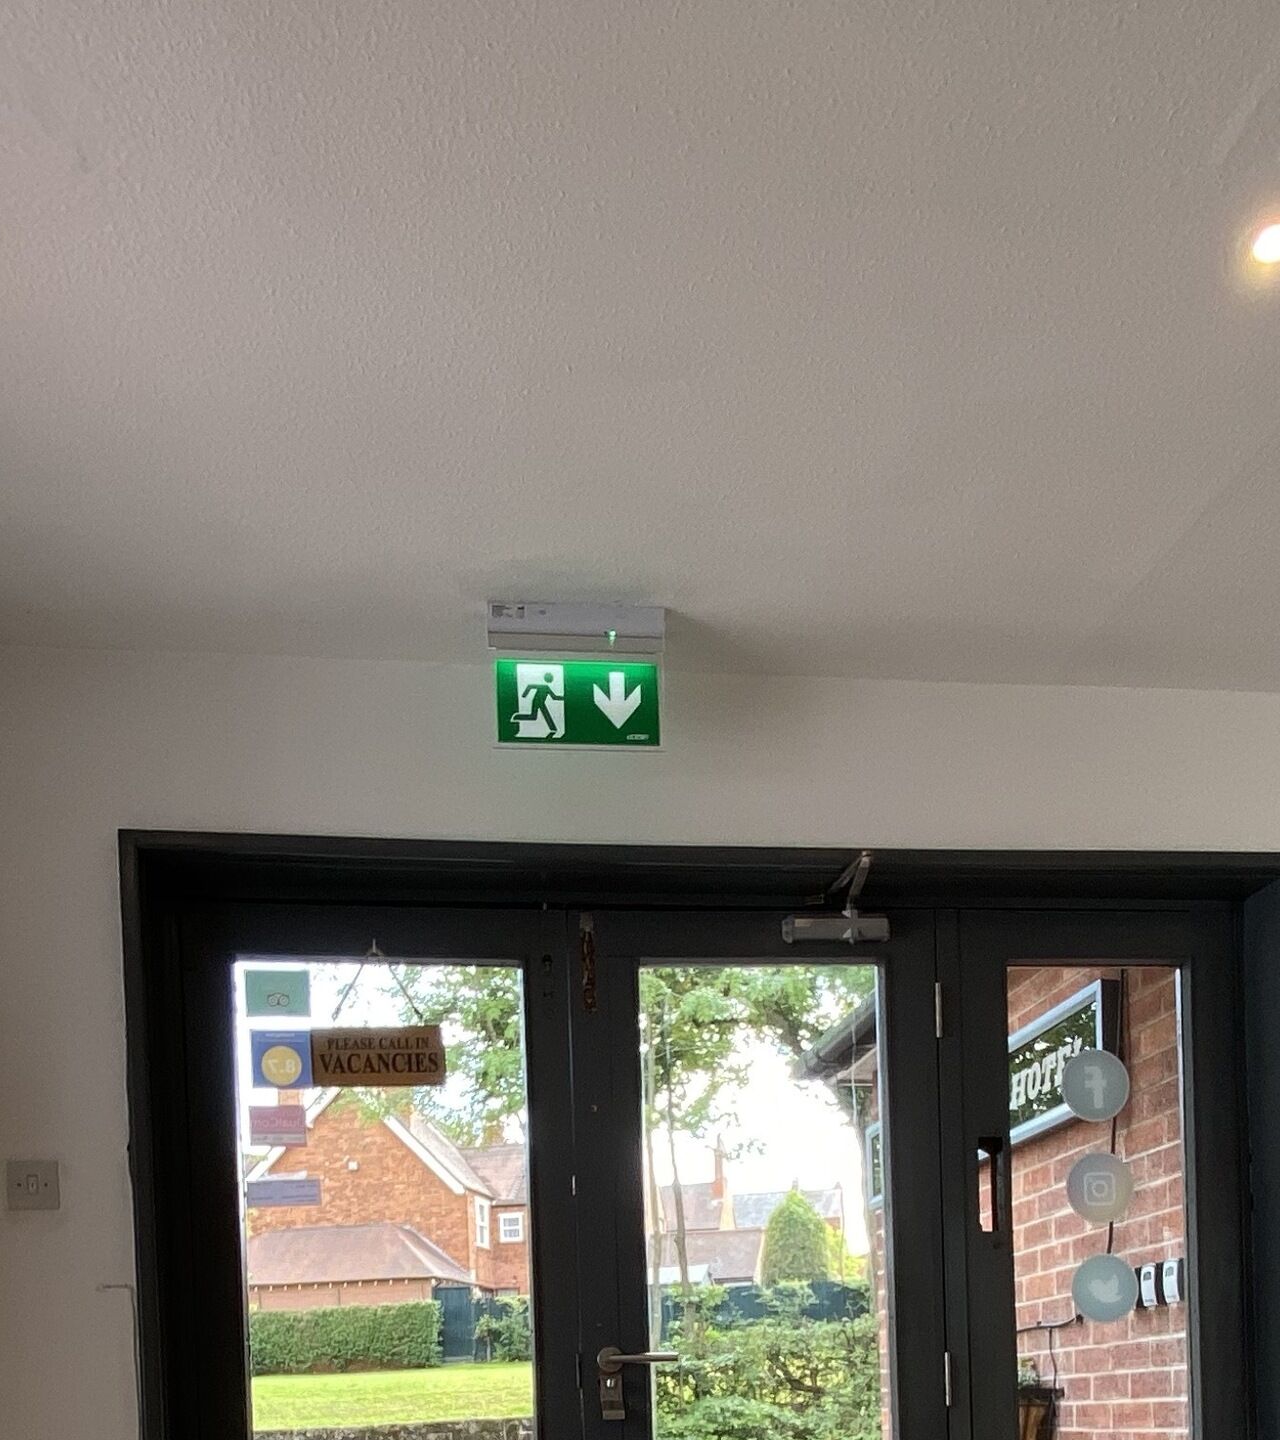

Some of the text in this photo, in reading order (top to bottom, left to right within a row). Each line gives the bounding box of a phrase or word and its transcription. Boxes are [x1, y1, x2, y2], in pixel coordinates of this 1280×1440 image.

[326, 1036, 430, 1050] PLEASE CALL IN
[319, 1052, 440, 1074] VACANCIES
